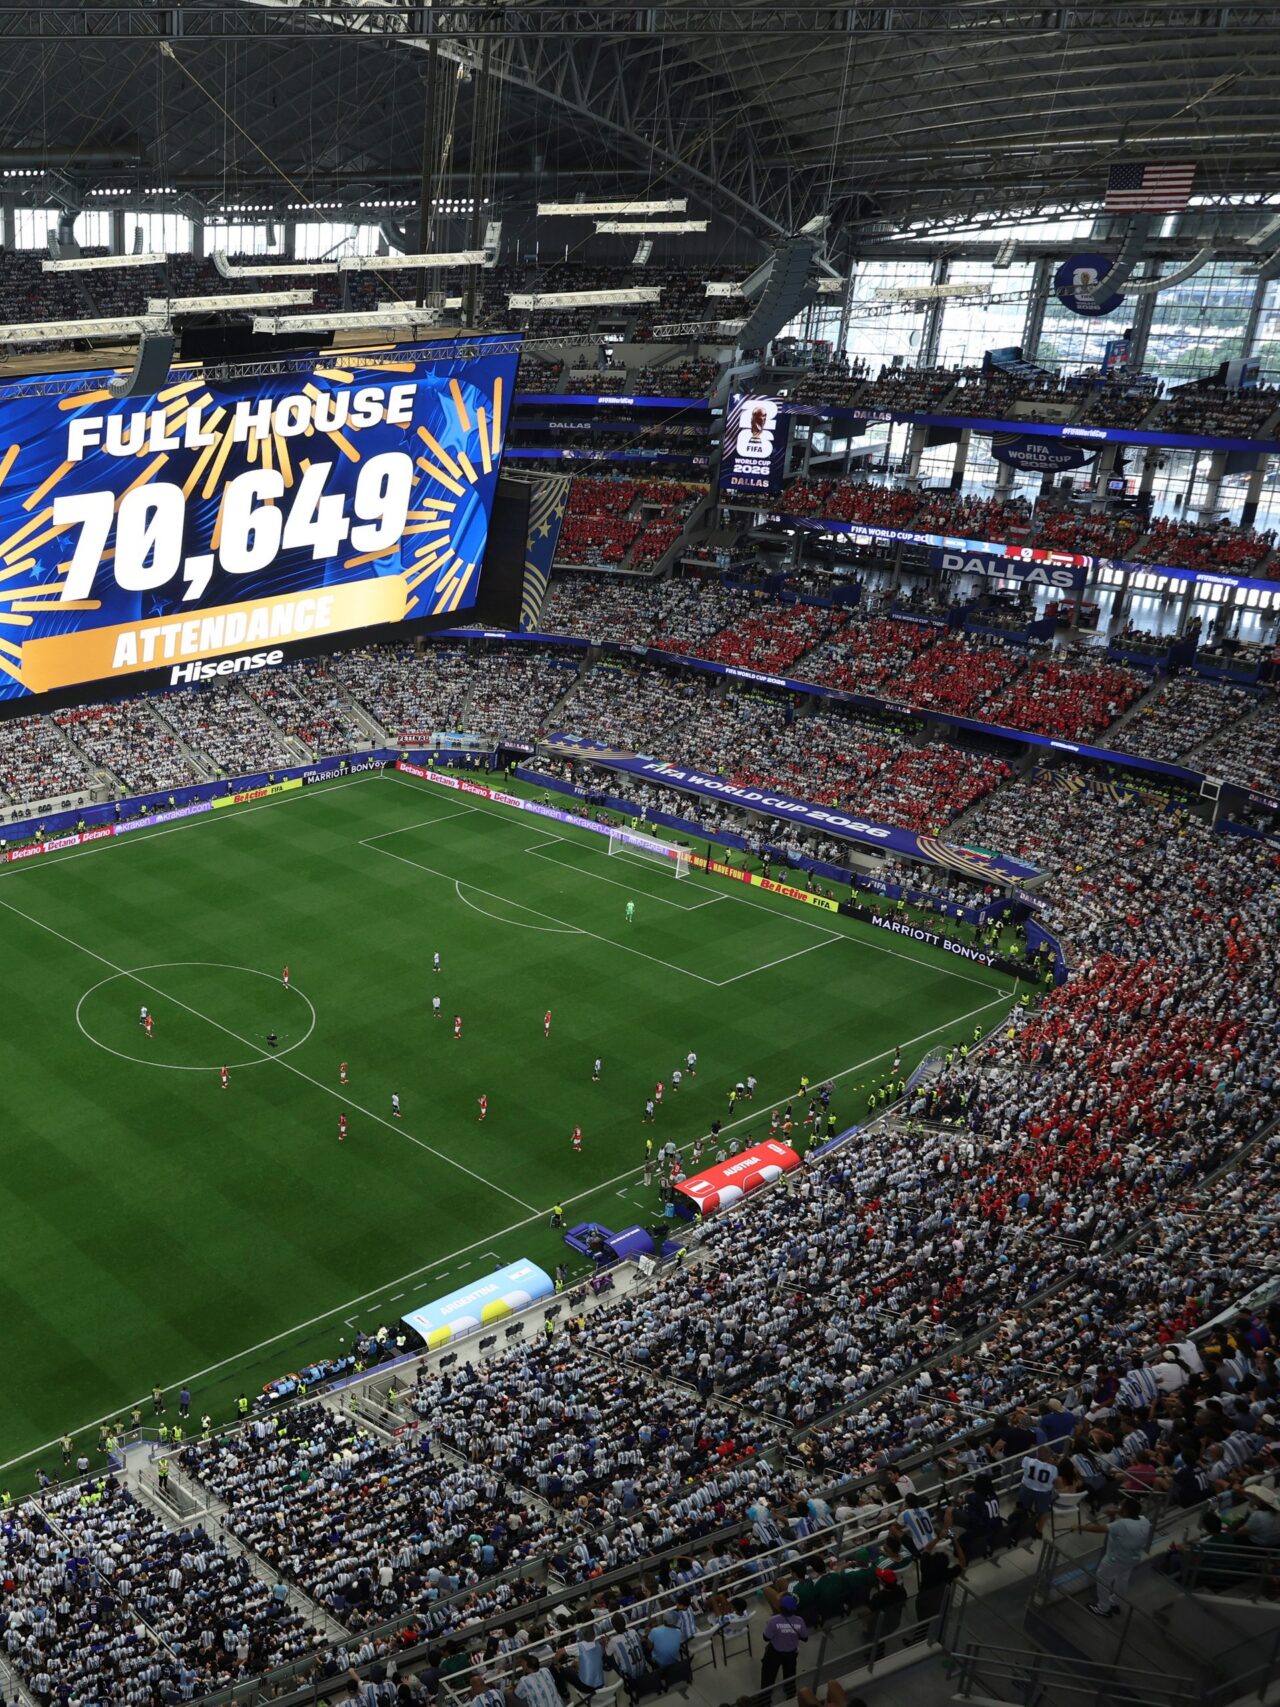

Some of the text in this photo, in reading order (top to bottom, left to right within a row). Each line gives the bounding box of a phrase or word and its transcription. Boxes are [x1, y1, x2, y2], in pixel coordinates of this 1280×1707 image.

[67, 384, 418, 462] FULL HOUSE
[853, 410, 892, 421] DALLAS
[549, 421, 591, 430] DALLAS
[746, 445, 763, 453] FIFA
[1008, 451, 1072, 463] WORLD CUP
[1026, 444, 1050, 454] FIFA
[733, 464, 770, 475] 2026
[731, 477, 769, 488] DALLAS
[53, 451, 413, 602] 70,649
[851, 525, 913, 541] FIFA WORLD CUP
[942, 554, 1074, 588] DALLAS
[112, 594, 332, 669] ATTENDANCE
[169, 648, 284, 686] Hisense
[725, 667, 786, 686] FIFA WORLD CUP 2026
[885, 703, 911, 714] DALLAS
[505, 741, 529, 750] DALLAS
[307, 760, 387, 785] MARRIOTT BONVOY
[271, 785, 283, 794] FIFA
[400, 763, 424, 777] Betano
[430, 773, 455, 787] Betano
[461, 783, 487, 797] Betano
[494, 792, 521, 808] Betano
[245, 789, 267, 802] Active
[643, 762, 891, 838] FIFA WORLD CUP 2026
[1248, 793, 1279, 809] DALLAS
[12, 828, 111, 861] Betano Betano Betano
[713, 862, 745, 881] HAVE FUN!
[760, 878, 808, 903] Be Active
[871, 880, 887, 892] FIFA
[813, 897, 831, 910] FIFA
[1020, 892, 1047, 909] DALLAS
[871, 915, 995, 967] MARRIOTT BONVOY
[722, 1156, 762, 1177] AUSTRIA
[440, 1283, 500, 1315] ARGENTINA
[1028, 1465, 1051, 1484] 10
[984, 1499, 1000, 1519] 10
[764, 1523, 780, 1539] 10
[916, 1516, 933, 1536] 10
[628, 1646, 644, 1664] 10
